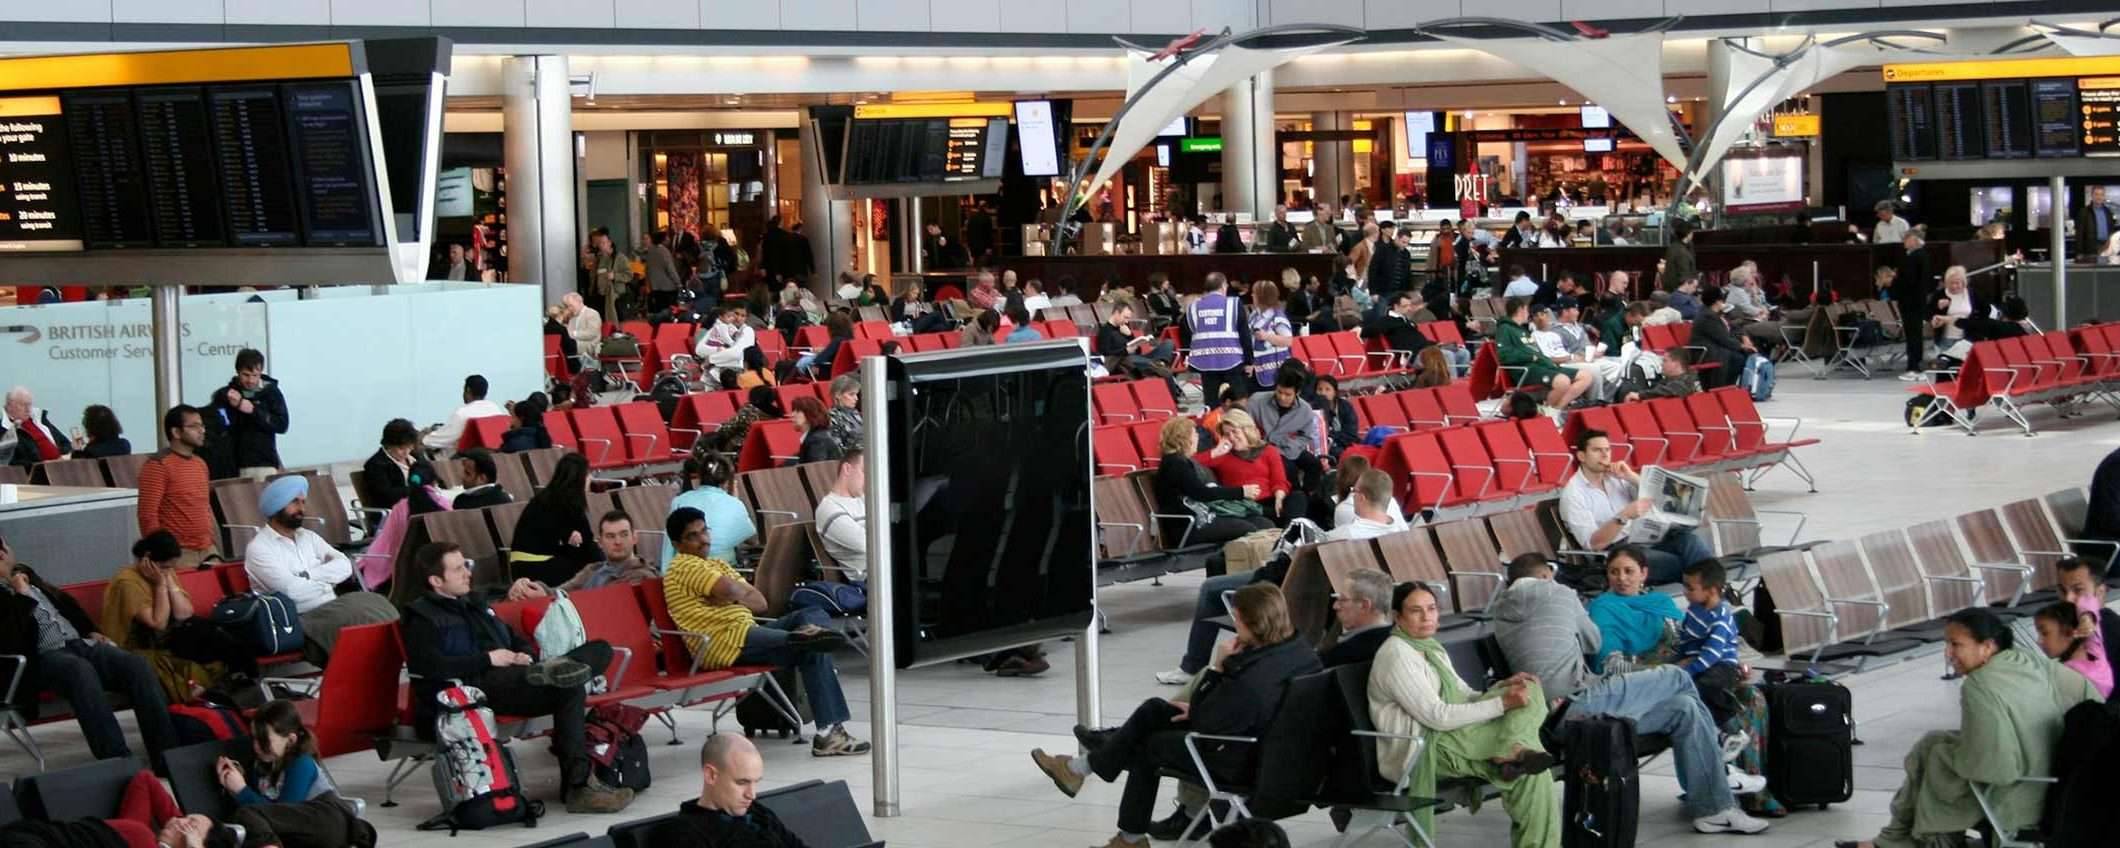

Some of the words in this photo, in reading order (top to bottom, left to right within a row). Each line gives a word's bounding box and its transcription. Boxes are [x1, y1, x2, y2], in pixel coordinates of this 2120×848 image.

[10, 121, 43, 133] following
[2, 134, 18, 144] your
[18, 133, 35, 143] gate
[9, 153, 17, 162] 10
[17, 152, 46, 162] minutes
[13, 182, 23, 191] 15
[23, 181, 51, 191] minutes
[1454, 173, 1489, 201] PRET
[18, 211, 28, 220] 20
[28, 210, 56, 220] minutes
[49, 326, 116, 340] BRITISH
[119, 322, 191, 339] AIRS
[49, 345, 117, 361] Customer
